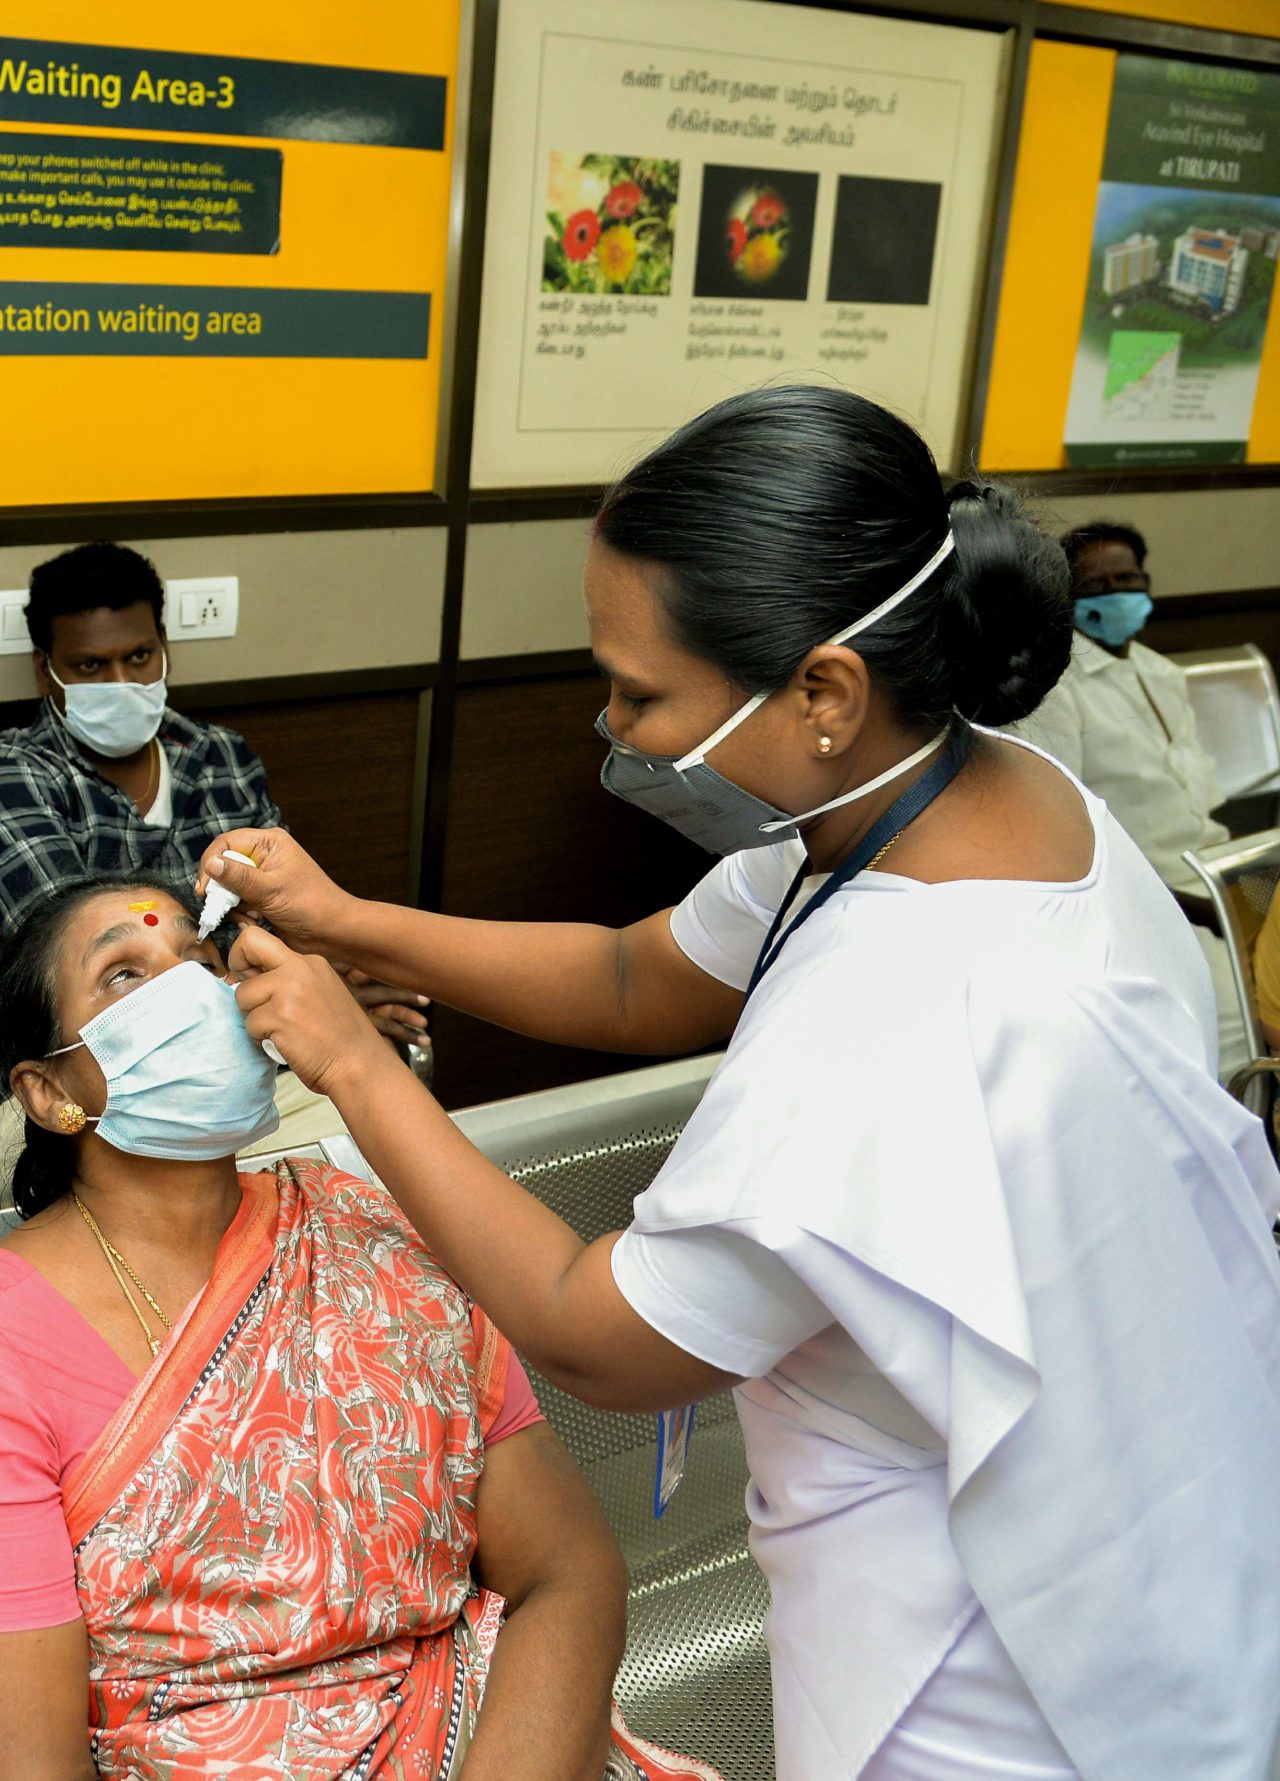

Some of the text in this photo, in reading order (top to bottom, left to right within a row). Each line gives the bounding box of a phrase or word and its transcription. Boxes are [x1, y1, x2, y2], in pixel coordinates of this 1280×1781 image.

[130, 70, 235, 108] Area-3
[622, 66, 664, 89] கண்
[669, 69, 779, 104] பரிசோதனை
[0, 169, 27, 182] make
[29, 169, 79, 185] important
[80, 171, 105, 187] calls,
[105, 176, 125, 189] you
[126, 175, 147, 189] may
[148, 177, 166, 188] use
[166, 175, 175, 189] it
[176, 177, 211, 191] outside
[212, 178, 228, 192] the
[17, 155, 41, 167] your
[42, 153, 79, 168] phones
[81, 156, 124, 171] switched
[125, 156, 141, 171] off
[142, 158, 169, 173] while
[171, 159, 181, 172] in
[182, 160, 198, 174] the
[96, 303, 200, 342] waiting
[204, 310, 261, 334] area
